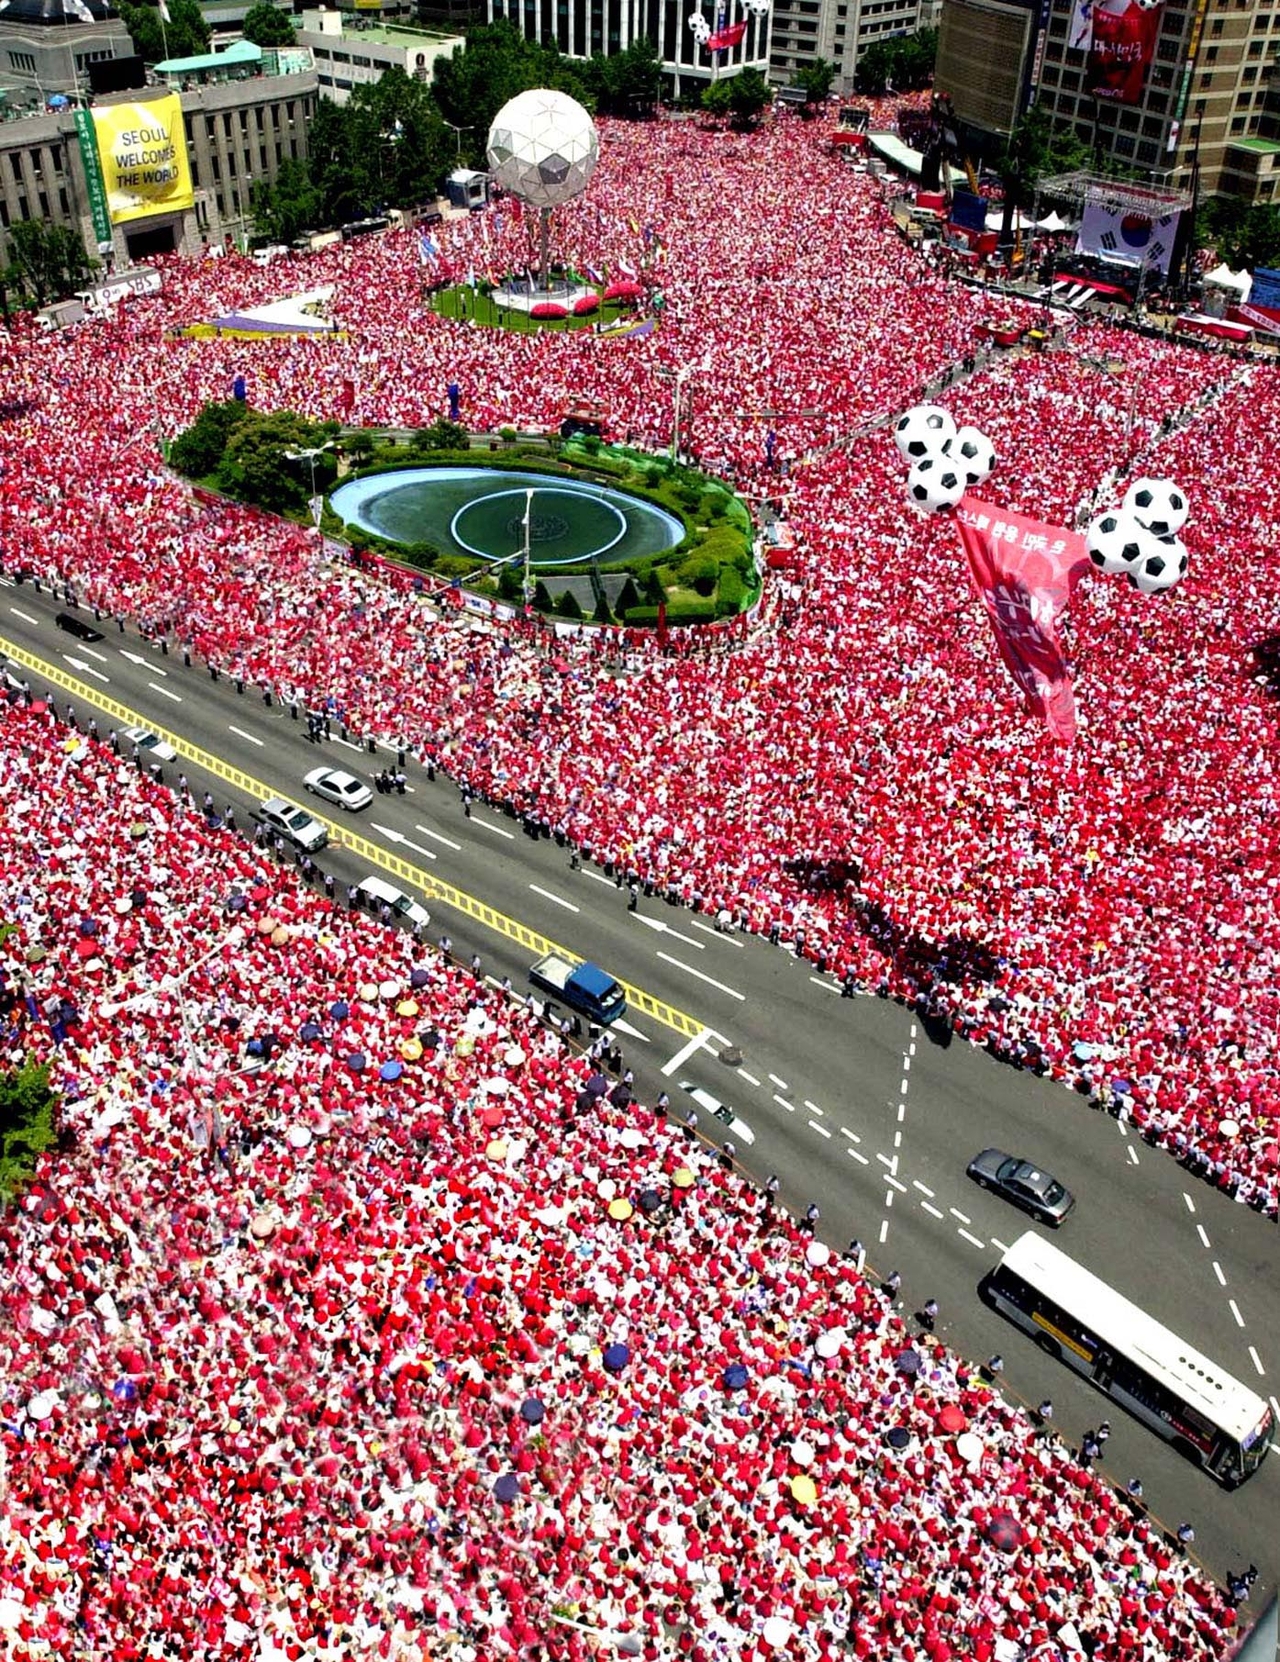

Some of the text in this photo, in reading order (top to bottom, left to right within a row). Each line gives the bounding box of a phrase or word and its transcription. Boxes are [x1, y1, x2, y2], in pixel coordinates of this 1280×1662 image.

[122, 127, 169, 147] SEOUL
[116, 145, 176, 169] WELCOMES
[116, 165, 179, 188] THE WORLD
[126, 275, 153, 292] SBS
